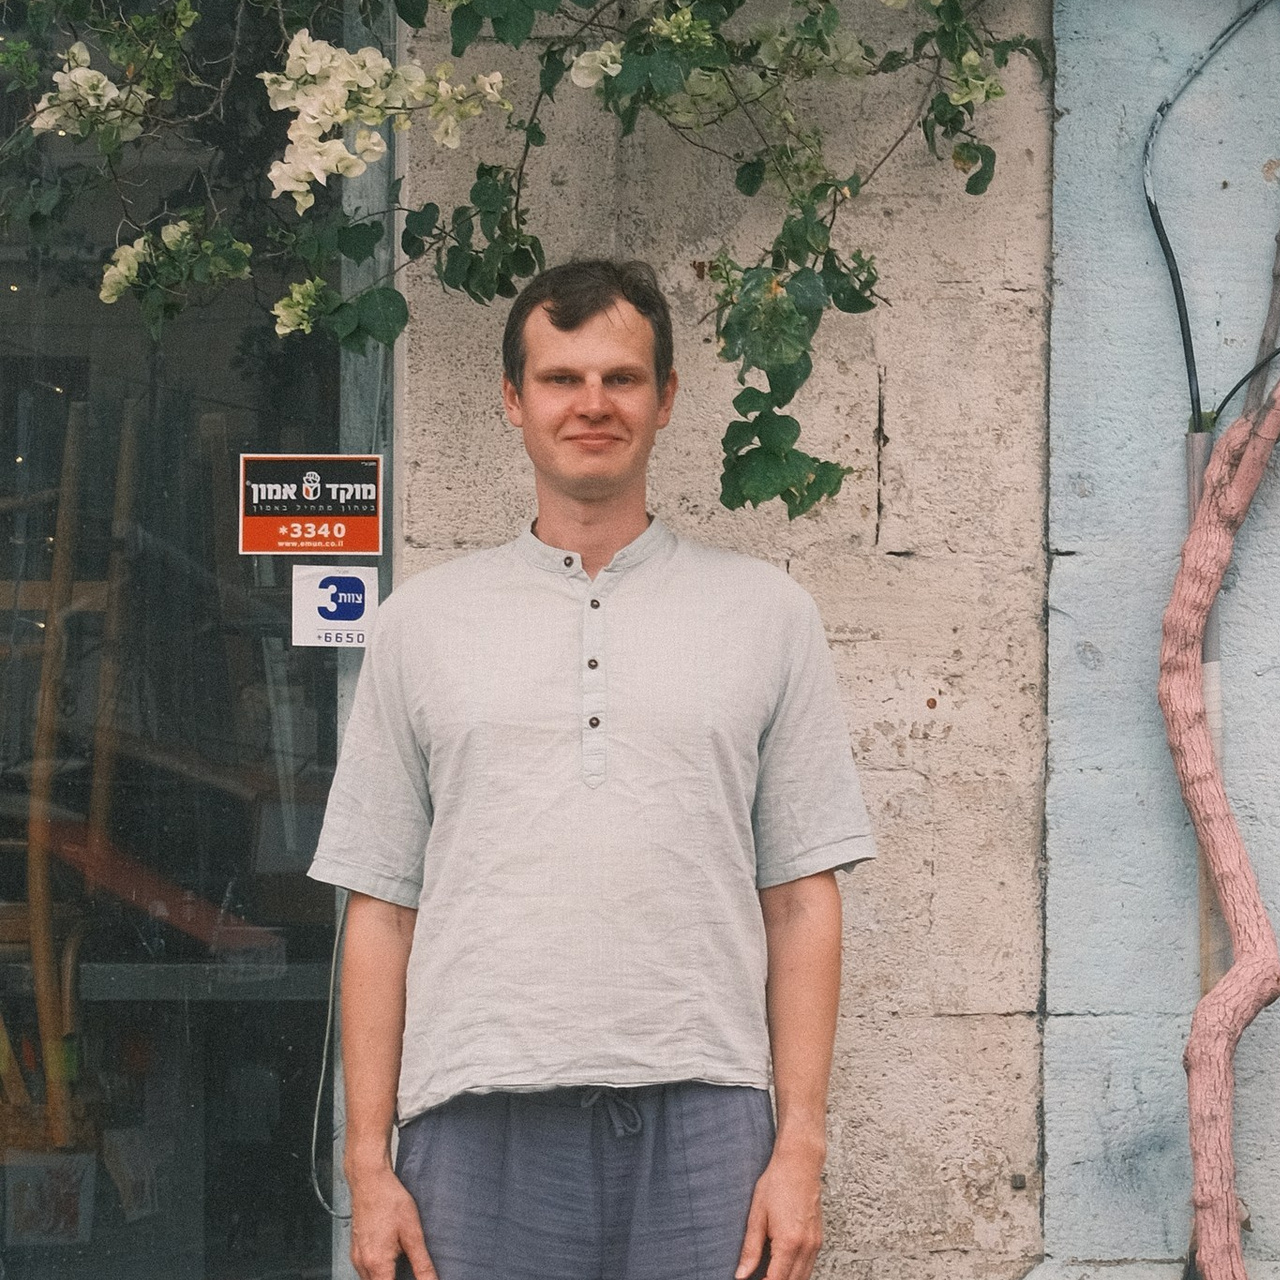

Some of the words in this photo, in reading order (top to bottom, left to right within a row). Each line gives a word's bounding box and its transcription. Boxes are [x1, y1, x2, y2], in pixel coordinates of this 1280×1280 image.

[250, 483, 298, 504] אמון
[325, 483, 376, 504] מוקד
[252, 504, 288, 513] באמון
[296, 504, 333, 512] מתחיל
[340, 504, 376, 512] בטחון
[277, 540, 344, 548] www.emun.co.il
[337, 592, 363, 604] צוות
